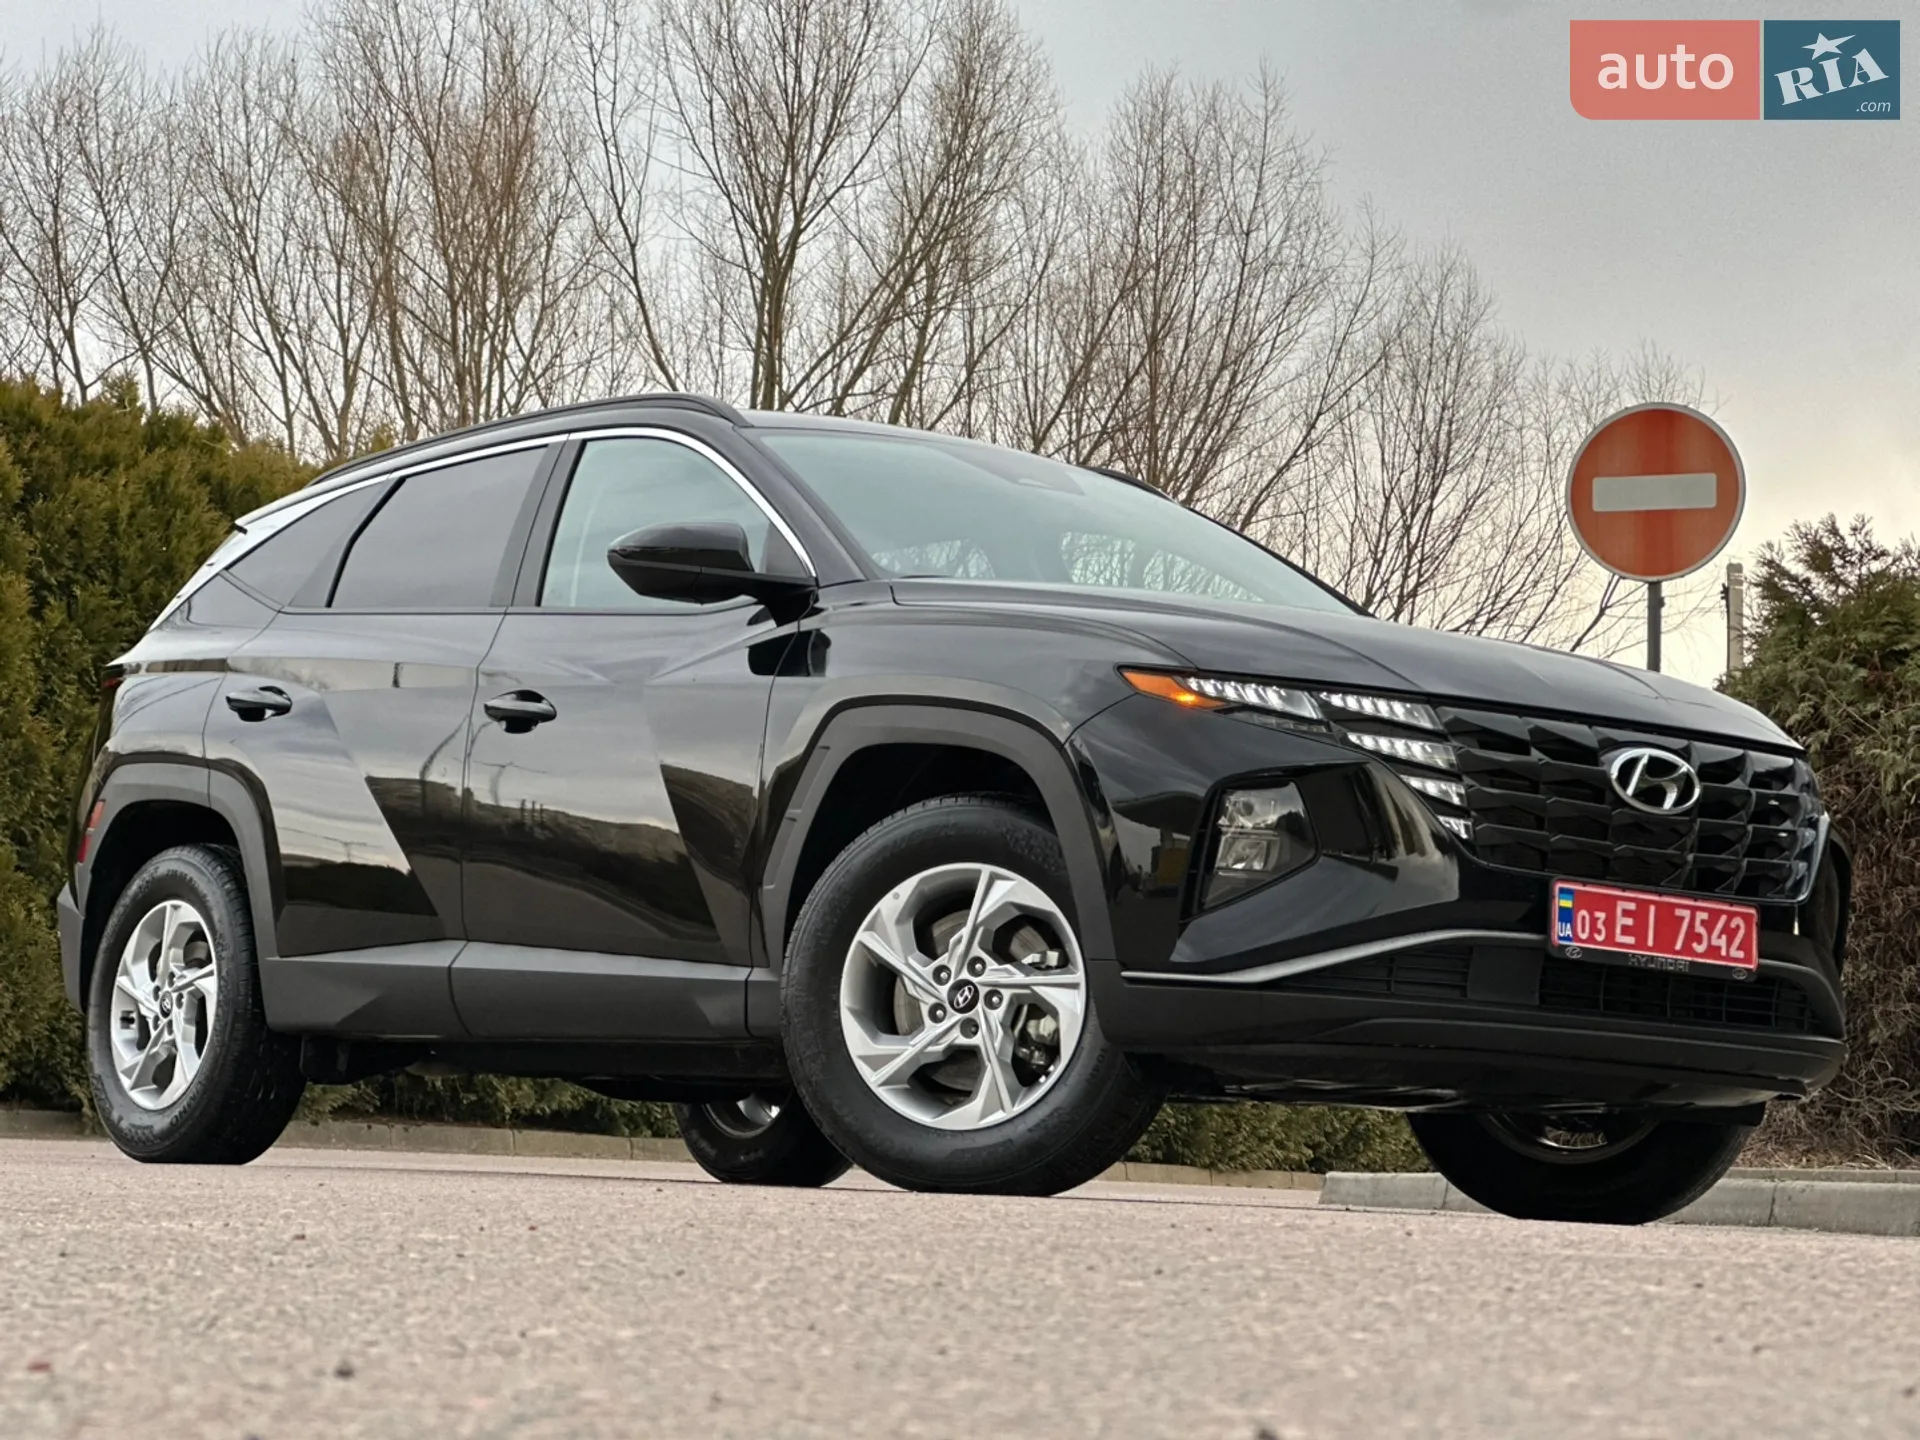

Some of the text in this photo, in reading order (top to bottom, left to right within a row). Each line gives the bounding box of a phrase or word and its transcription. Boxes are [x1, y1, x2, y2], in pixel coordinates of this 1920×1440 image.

[1558, 922, 1573, 938] UA
[1577, 900, 1746, 958] 03 EI 7542
[1627, 953, 1691, 973] HYUNDAI
